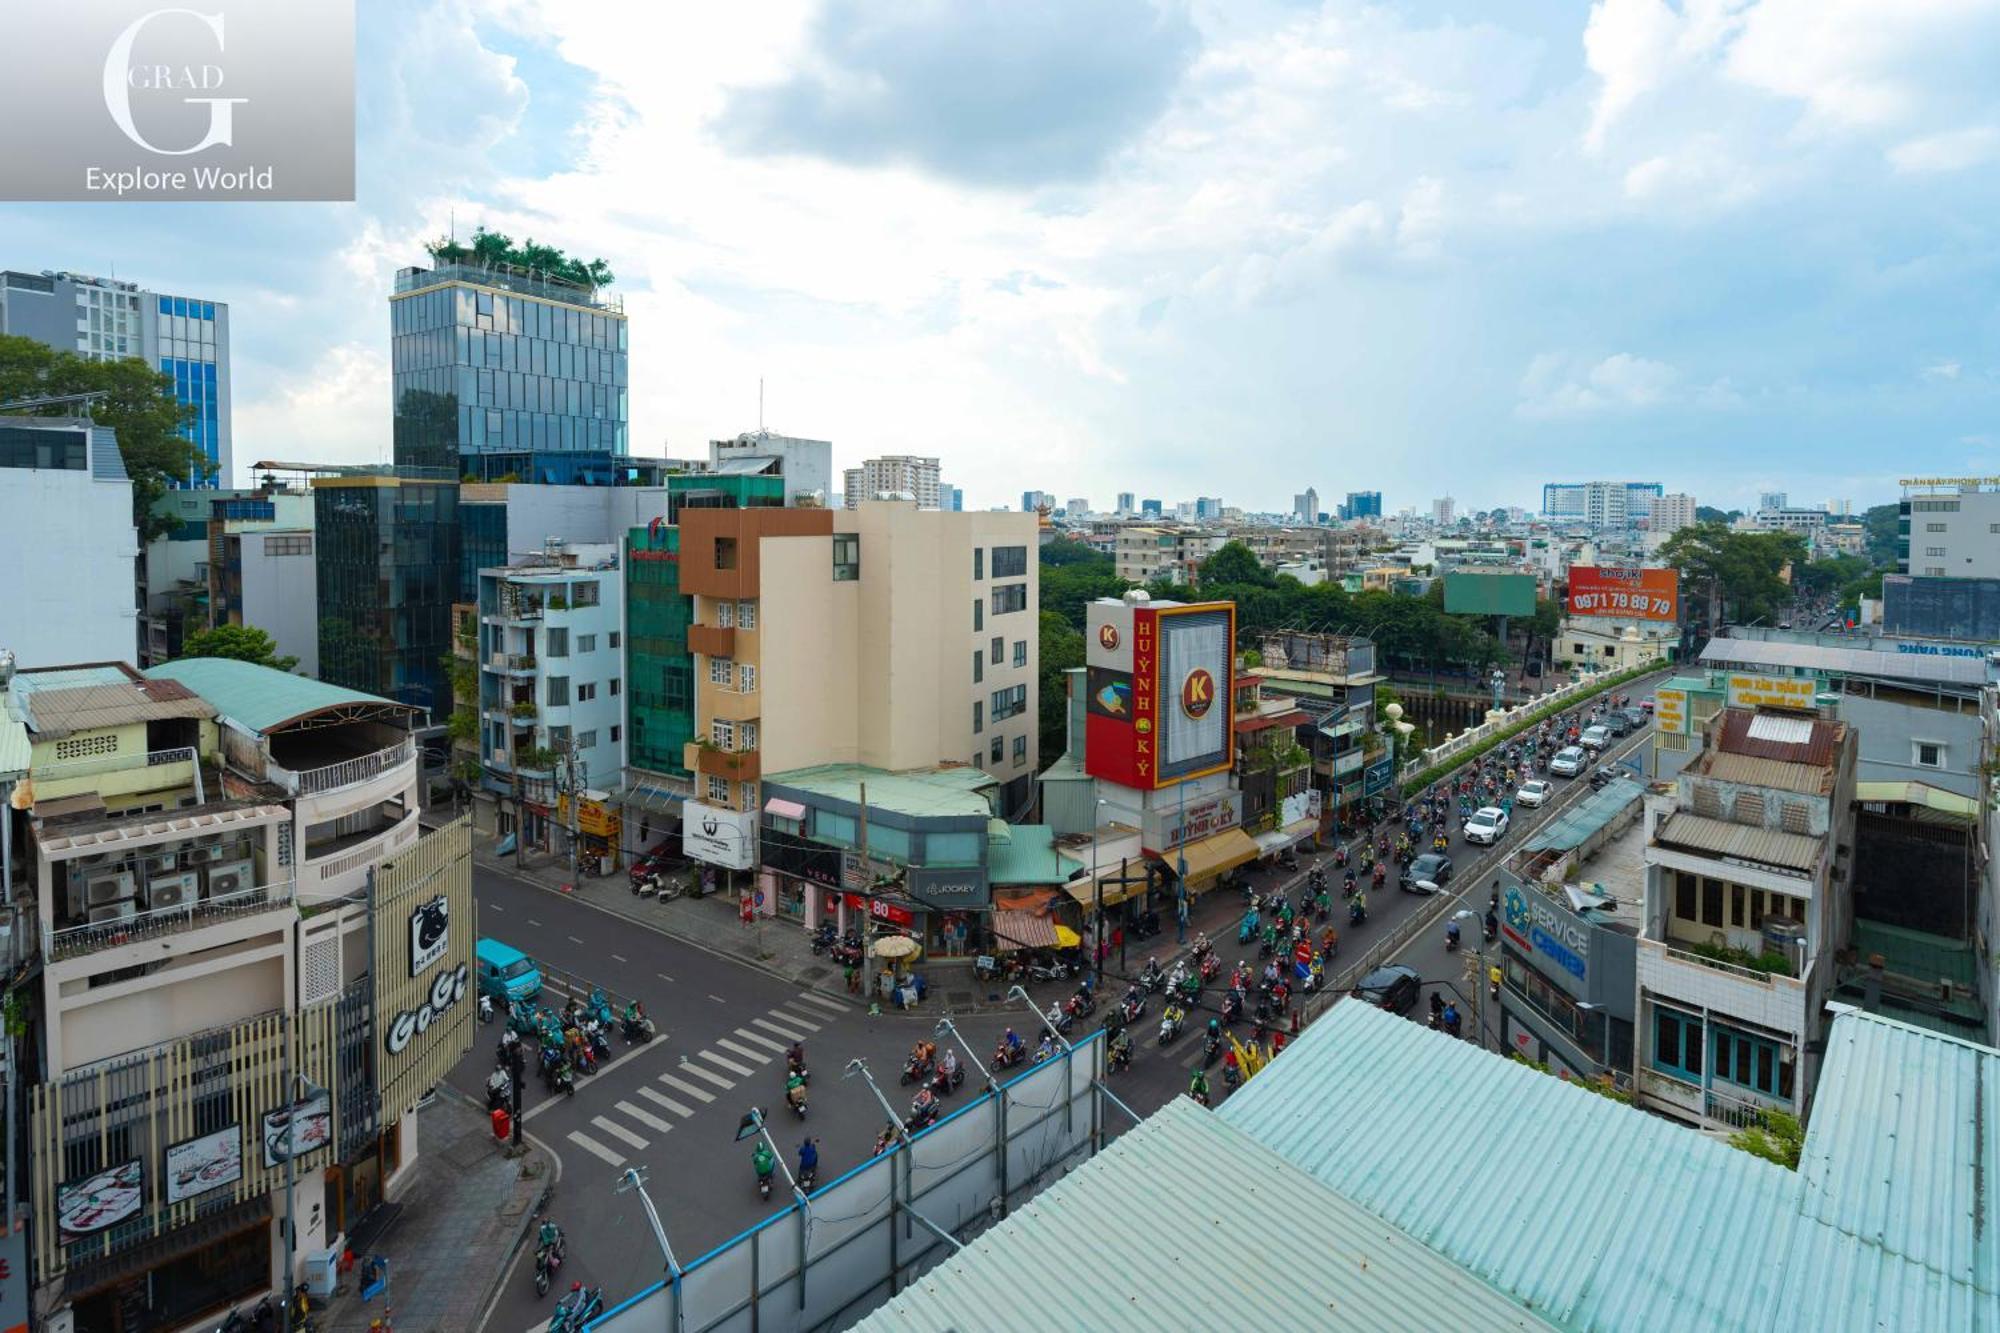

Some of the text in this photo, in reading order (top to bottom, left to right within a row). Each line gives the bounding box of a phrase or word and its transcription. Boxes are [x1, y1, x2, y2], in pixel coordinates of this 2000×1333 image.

[1103, 627, 1114, 642] K
[1191, 675, 1208, 703] K
[806, 867, 836, 885] VERA
[941, 884, 977, 894] JOCKEY
[1531, 902, 1587, 957] SERVICE
[1531, 926, 1586, 981] CENTER
